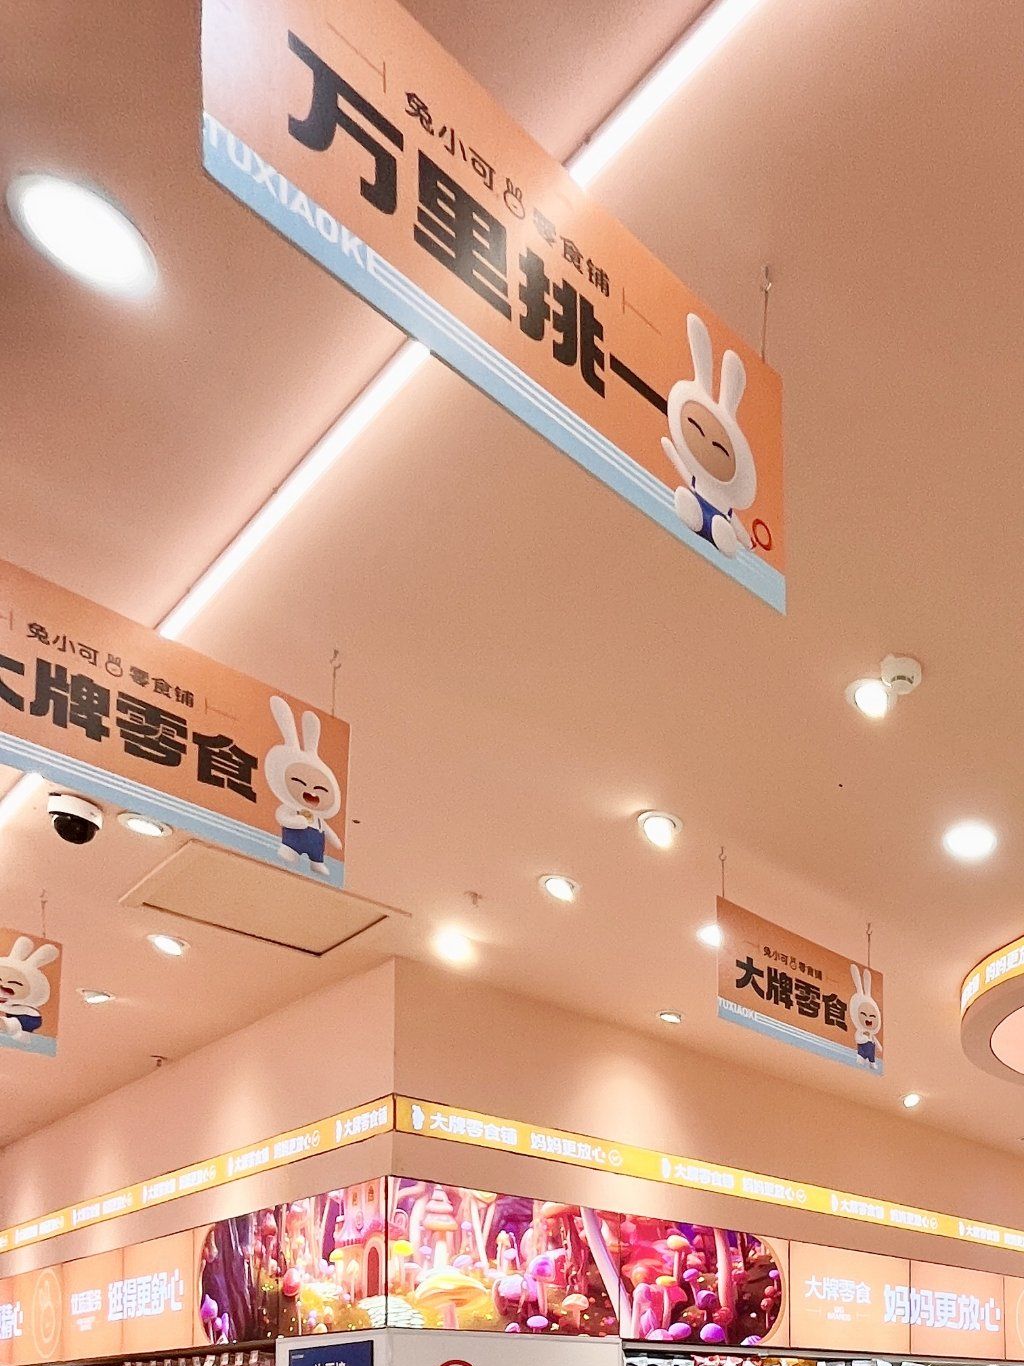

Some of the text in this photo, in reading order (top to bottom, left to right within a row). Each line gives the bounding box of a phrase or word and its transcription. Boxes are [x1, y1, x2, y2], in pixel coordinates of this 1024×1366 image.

[287, 28, 668, 416] 万里挑一
[404, 90, 610, 298] 兔小可 零食铺
[27, 621, 194, 708] 兔小可 零食铺
[736, 956, 848, 1032] 大牌零食
[429, 1112, 517, 1146] 大牌零食铺
[530, 1132, 606, 1163] 妈妈更放心
[805, 1275, 1000, 1332] 大牌零食 妈妈更放心
